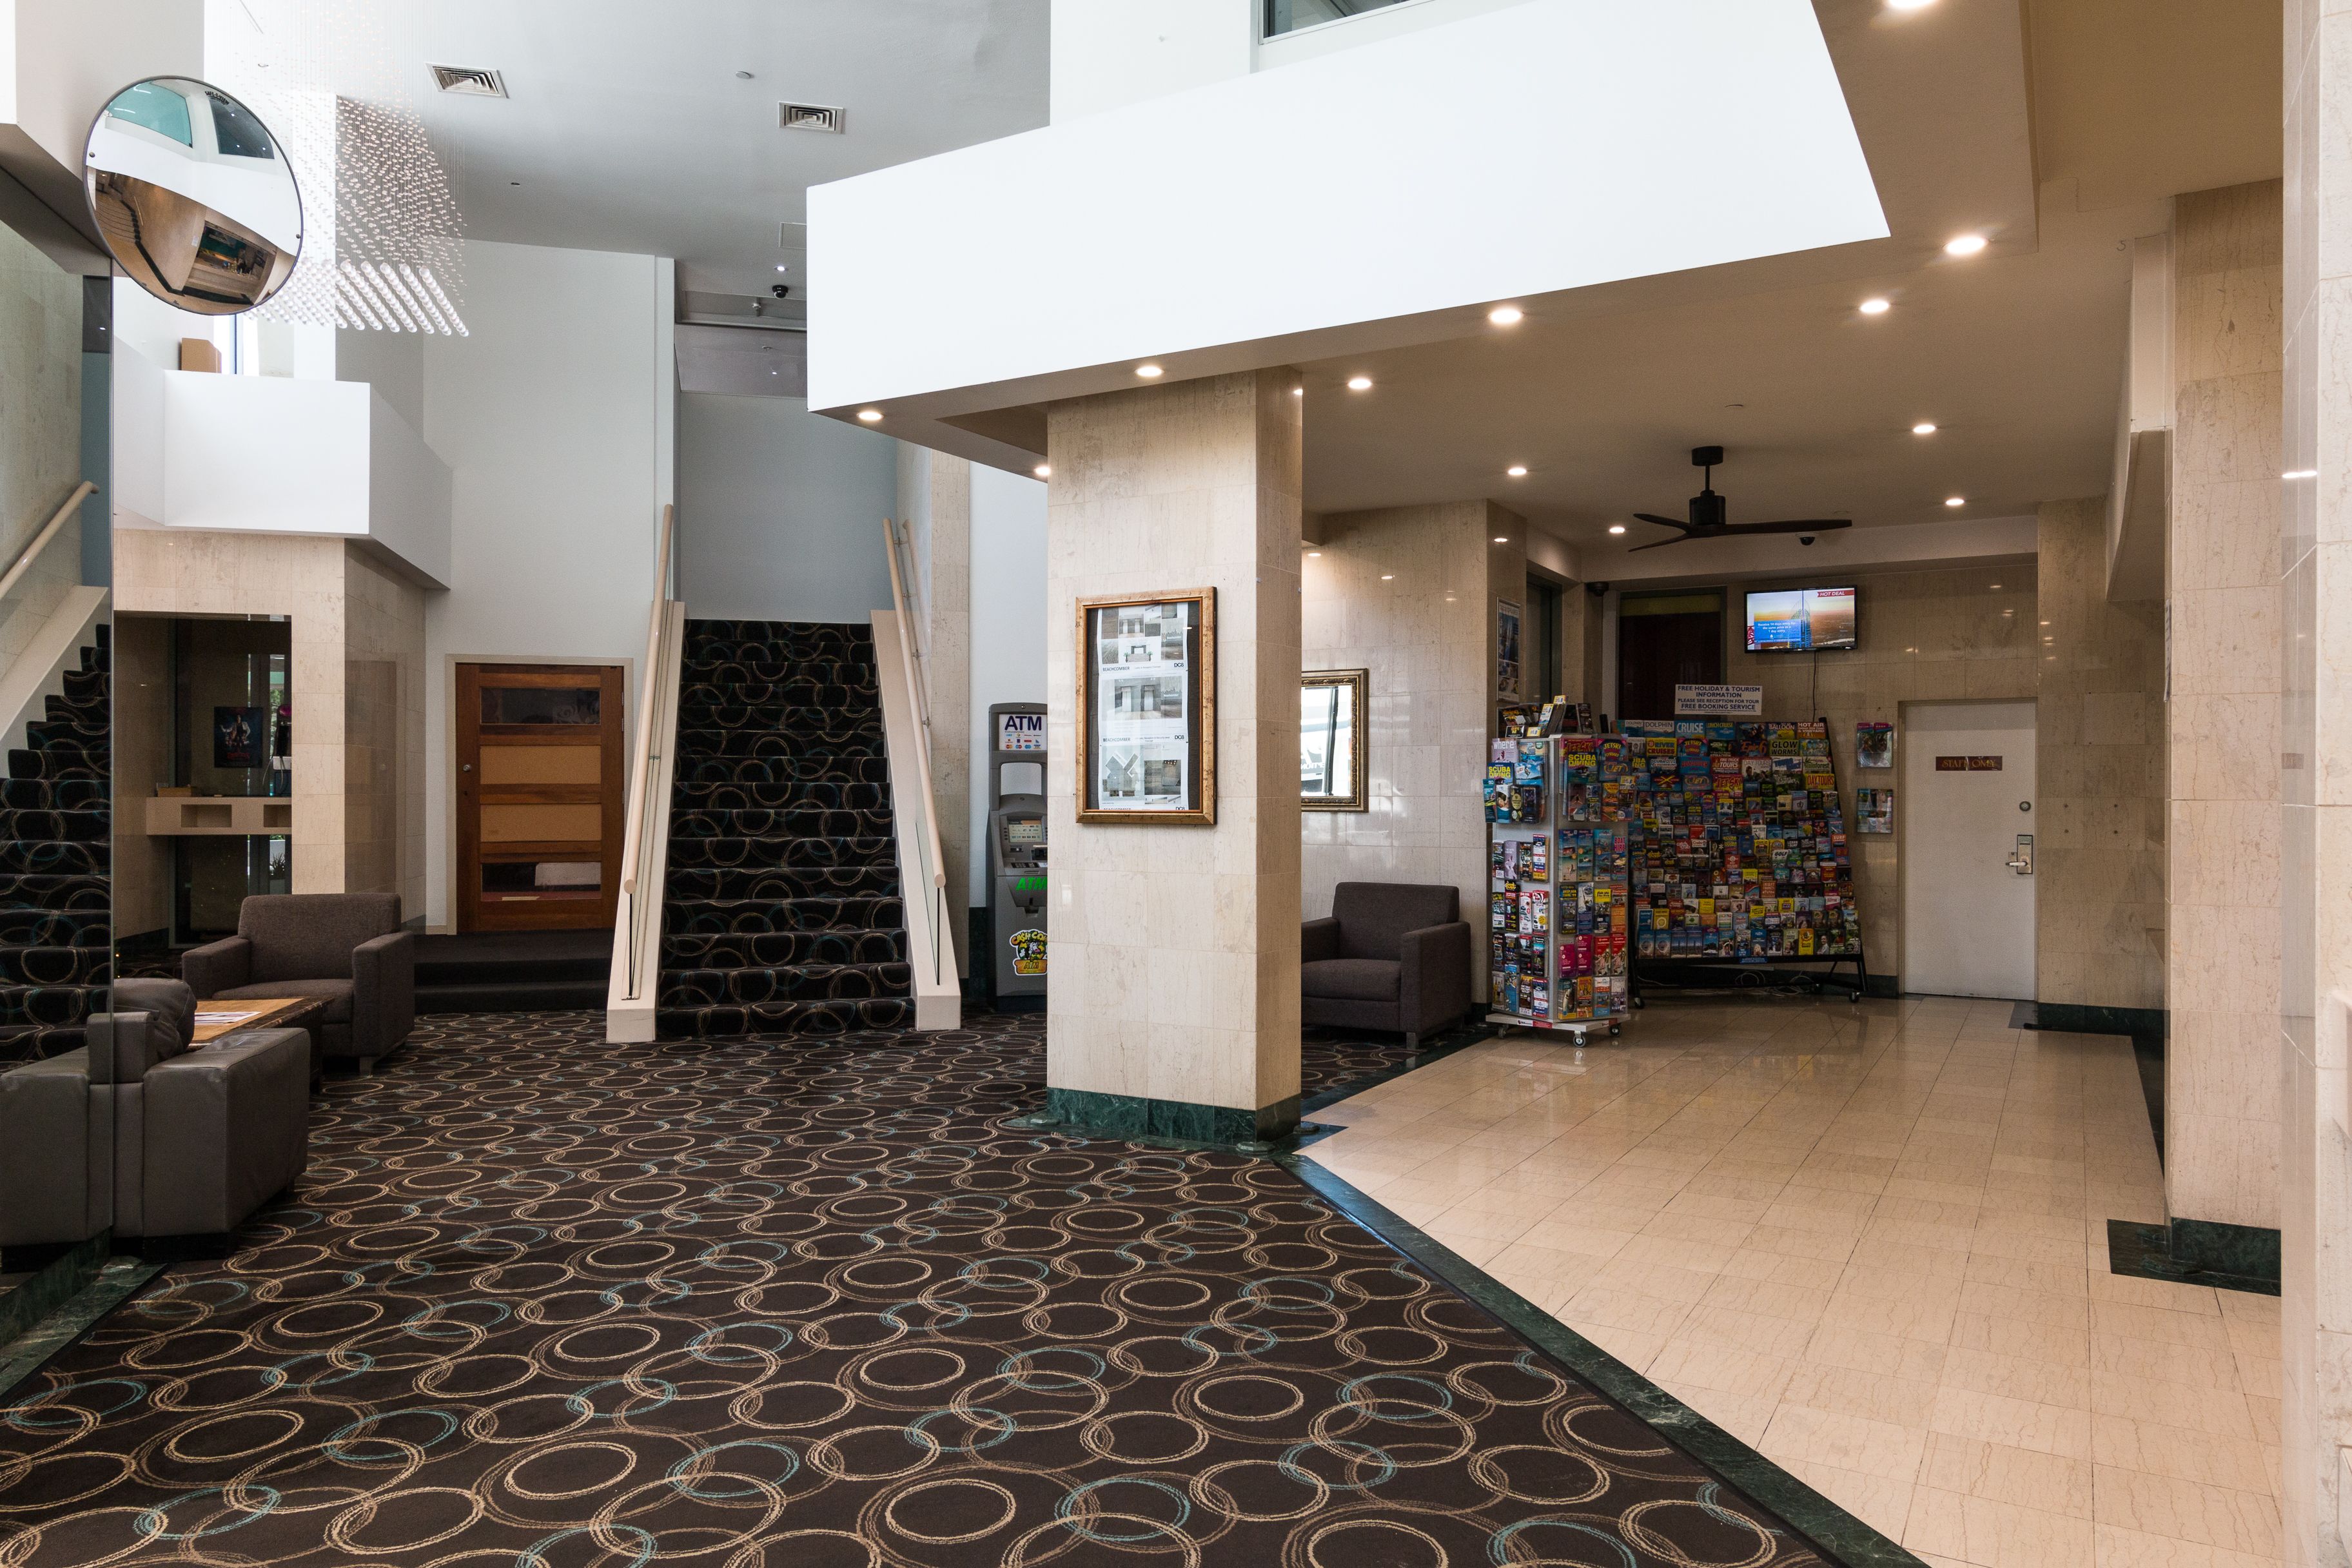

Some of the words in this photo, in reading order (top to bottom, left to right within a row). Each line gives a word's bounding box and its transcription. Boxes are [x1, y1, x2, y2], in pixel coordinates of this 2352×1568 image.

[1004, 716, 1042, 730] ATM
[1676, 723, 1704, 733] CRUISE
[1493, 739, 1514, 749] where
[1807, 776, 1818, 785] DAY
[1818, 776, 1834, 785] TOURS
[1015, 877, 1047, 890] ATM
[1010, 932, 1031, 946] CASH
[1023, 961, 1039, 970] ATM
